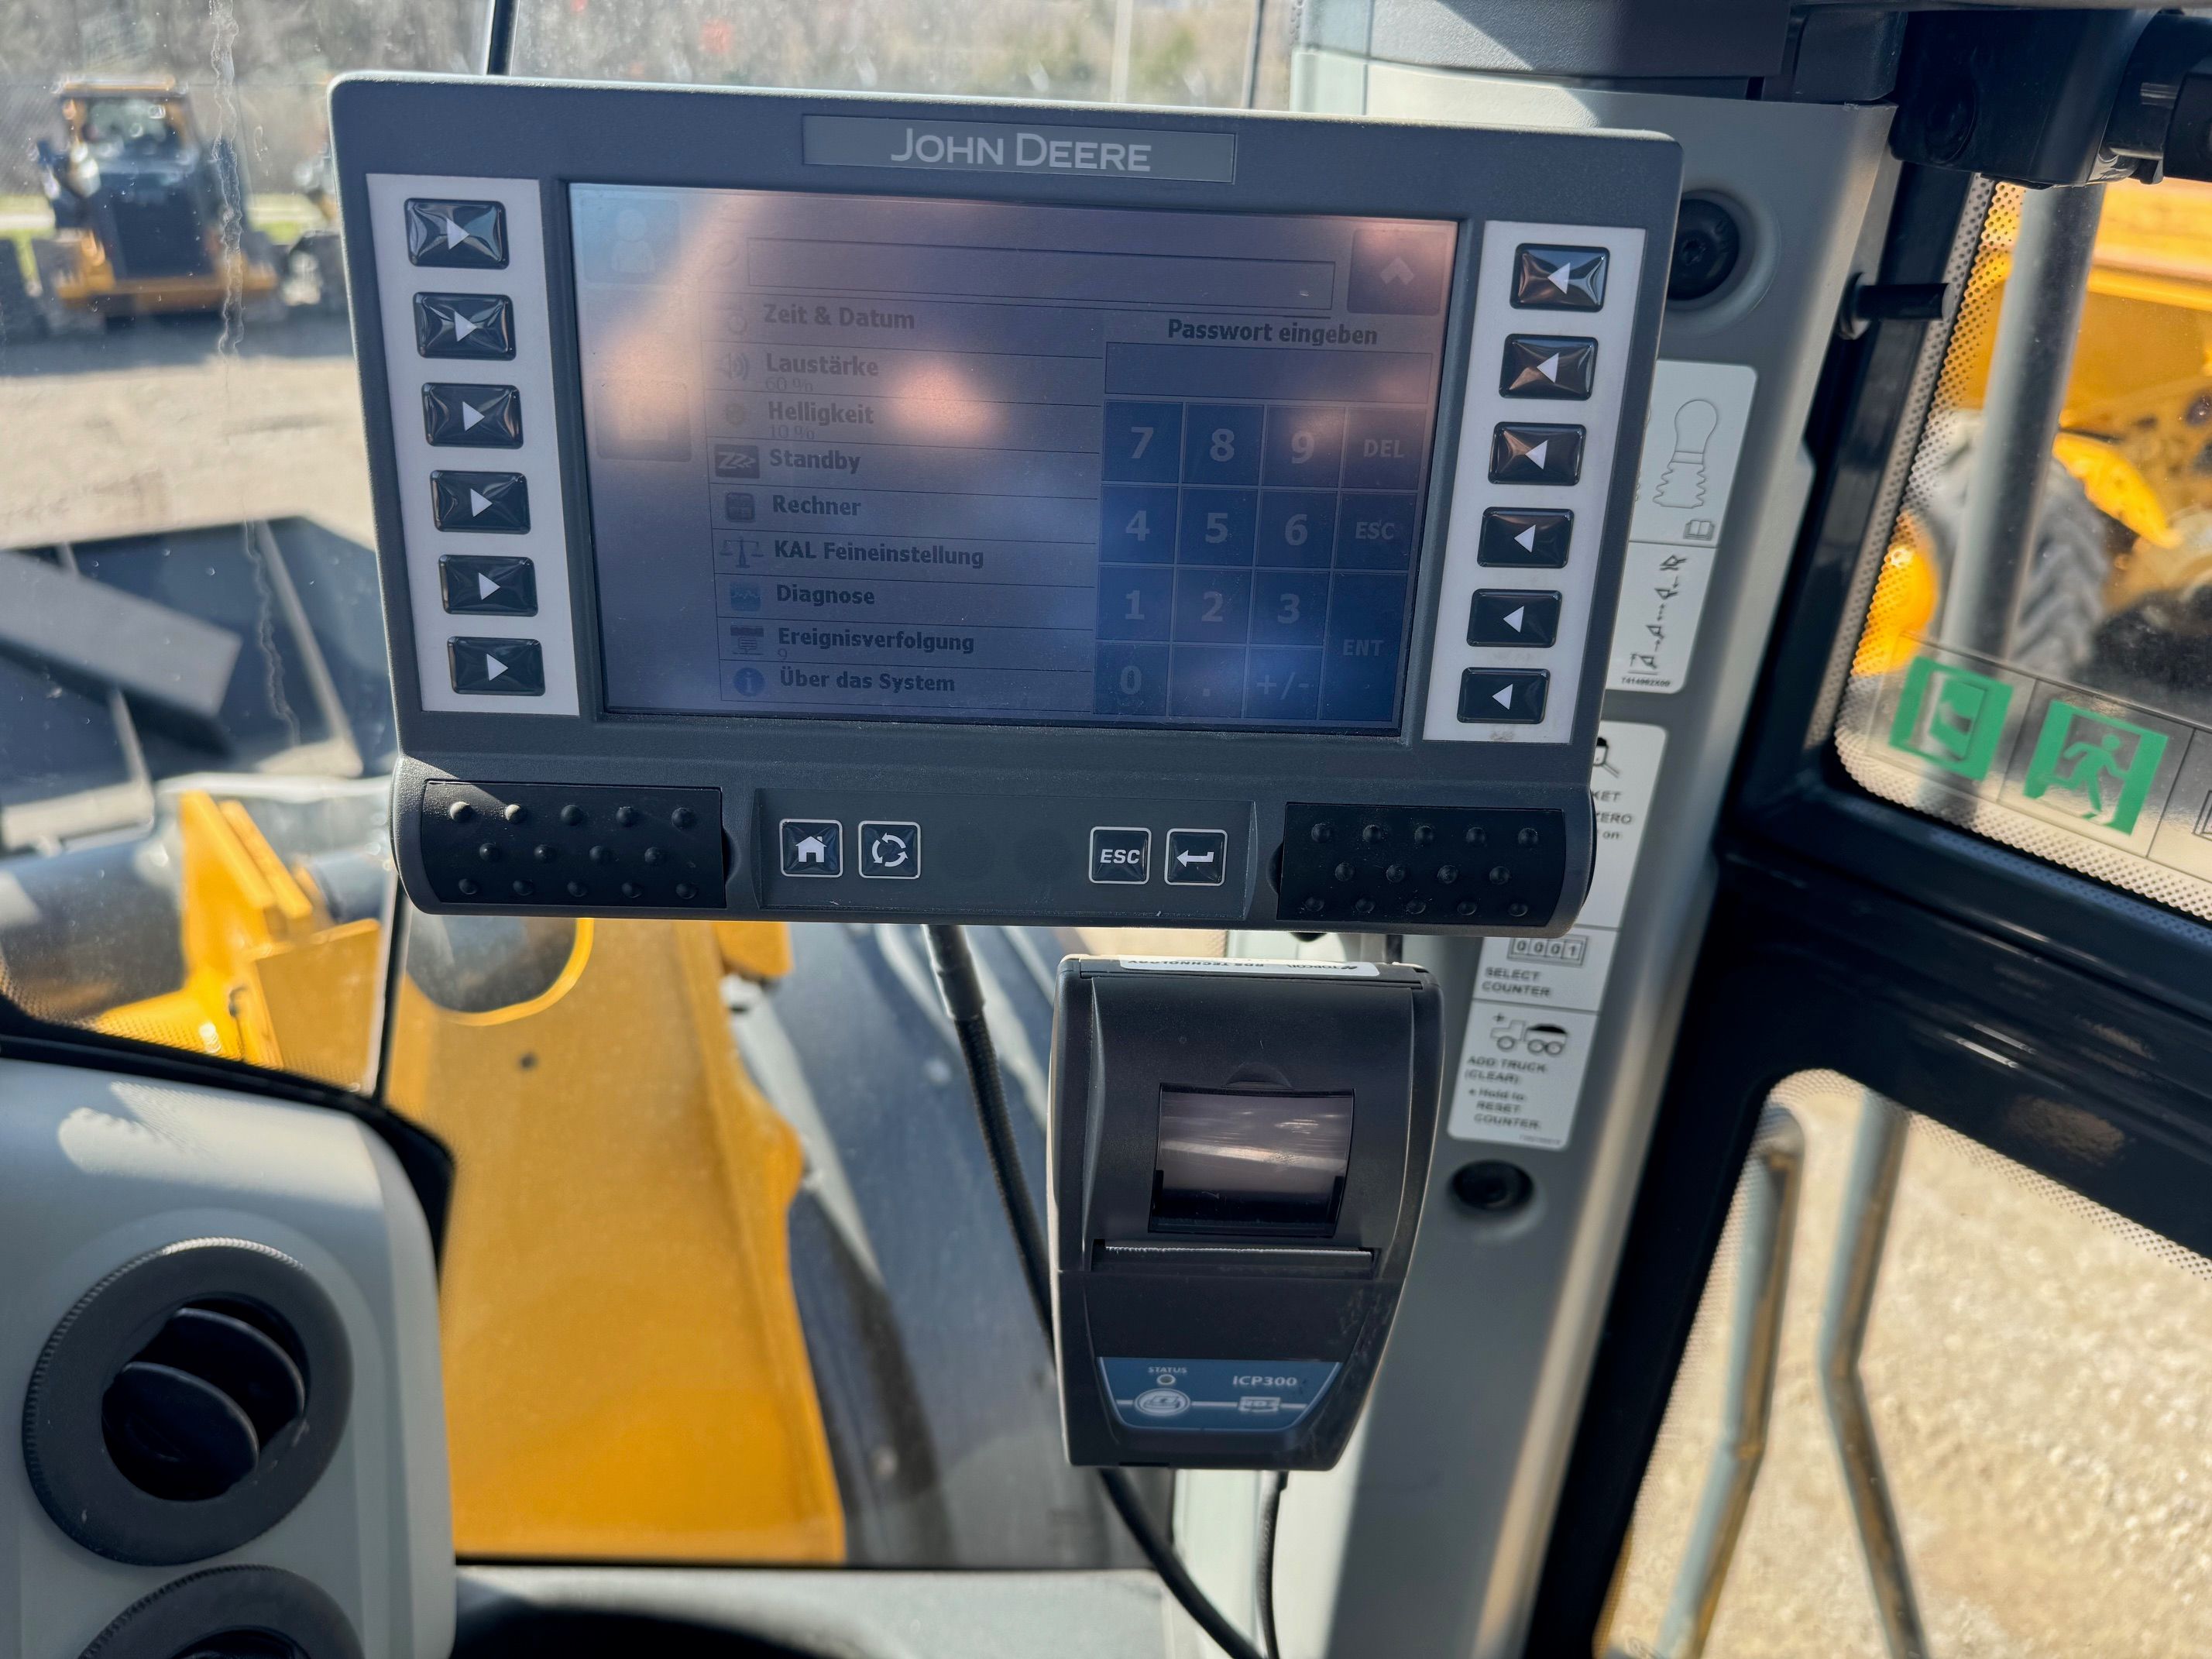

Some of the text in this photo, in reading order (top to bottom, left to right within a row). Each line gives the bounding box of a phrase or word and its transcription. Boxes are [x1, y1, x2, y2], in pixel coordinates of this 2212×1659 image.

[891, 129, 1152, 172] JOHN DEERE
[764, 303, 915, 330] Zeit & Datum
[1168, 319, 1378, 346] Passwort eingeben
[766, 352, 879, 377] Laustärke
[768, 400, 874, 426] Helligkeit
[1130, 427, 1155, 459] 7
[1209, 428, 1235, 462] 8
[1290, 431, 1316, 465] 9
[1363, 439, 1405, 459] DEL
[769, 448, 861, 475] Standby
[772, 495, 861, 517] Rechner
[1125, 510, 1151, 541] 4
[1204, 513, 1229, 544] 5
[1284, 514, 1308, 546] 6
[1355, 521, 1396, 541] ESC
[775, 540, 984, 569] KAL Feineinstellung
[776, 585, 875, 607] Diagnose
[1124, 589, 1145, 620] 1
[1200, 591, 1224, 622] 2
[1276, 593, 1300, 624] 3
[778, 627, 975, 654] Ereignisverfolgung
[1343, 639, 1385, 658] ENT
[780, 666, 956, 693] Über das System
[1119, 666, 1142, 696] 0
[1591, 790, 1623, 802] KET
[1596, 811, 1633, 825] ERO
[1100, 849, 1141, 865] ESC
[1486, 967, 1542, 981] SELECT
[1482, 981, 1552, 998] COUNTER
[1467, 1055, 1547, 1073] ADD TRUCK
[1476, 1100, 1522, 1114] RESET
[1148, 1365, 1188, 1374] STATUS
[1232, 1375, 1298, 1386] ICP300
